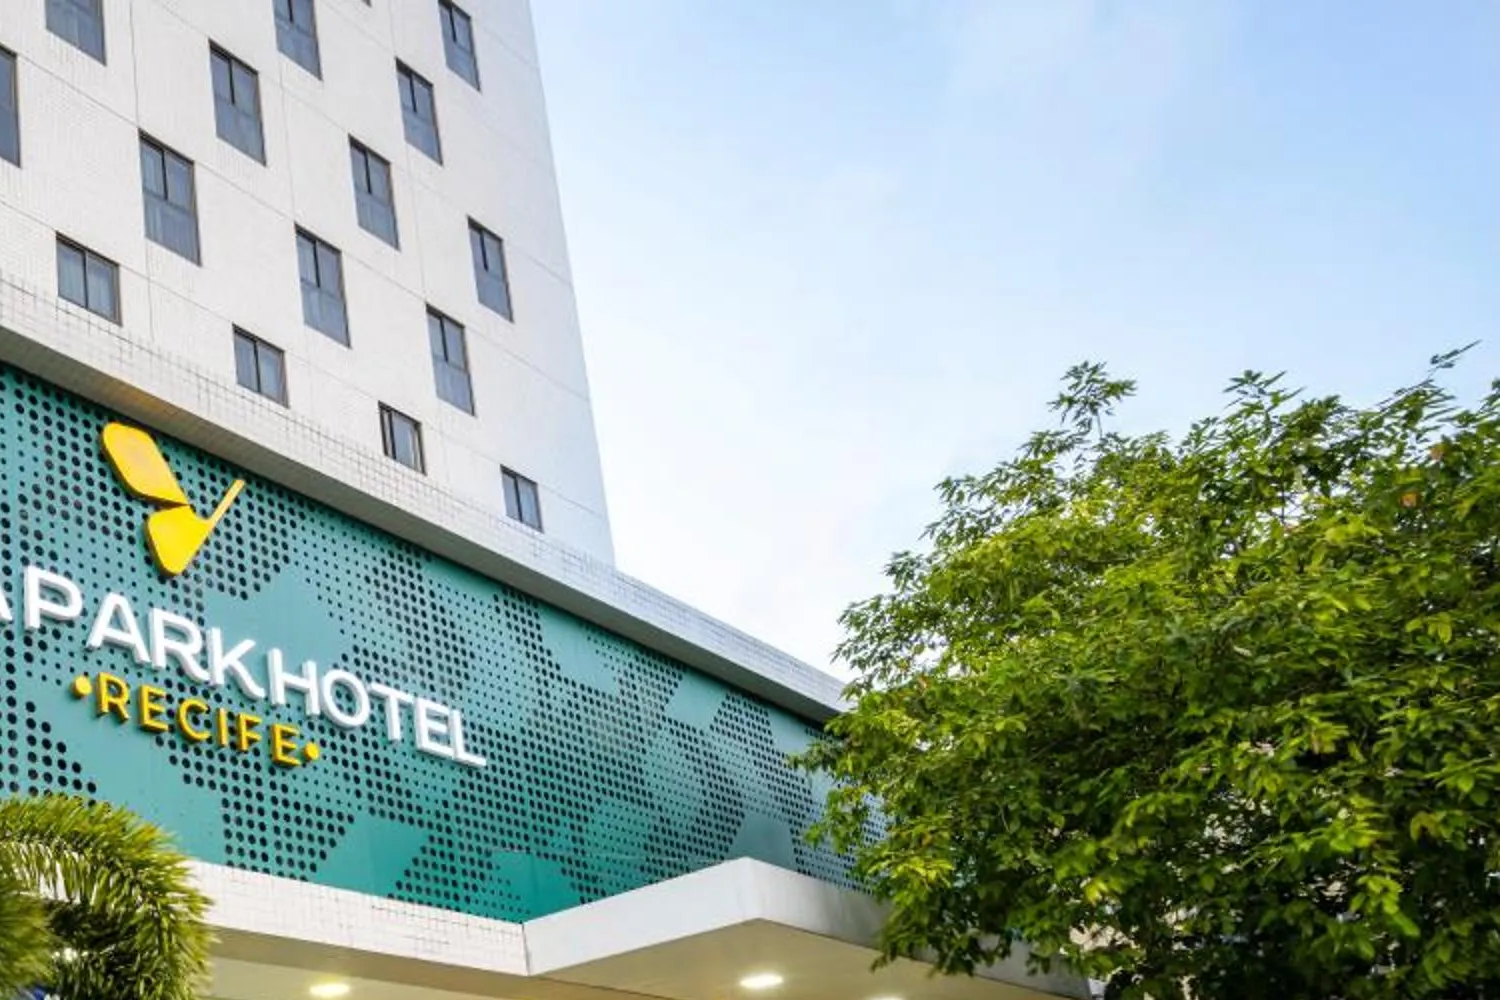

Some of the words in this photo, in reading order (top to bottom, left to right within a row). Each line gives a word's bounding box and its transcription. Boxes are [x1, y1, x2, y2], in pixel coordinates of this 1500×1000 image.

[23, 566, 268, 699] PARK
[267, 649, 488, 767] HOTEL
[97, 673, 303, 767] RECIFE
